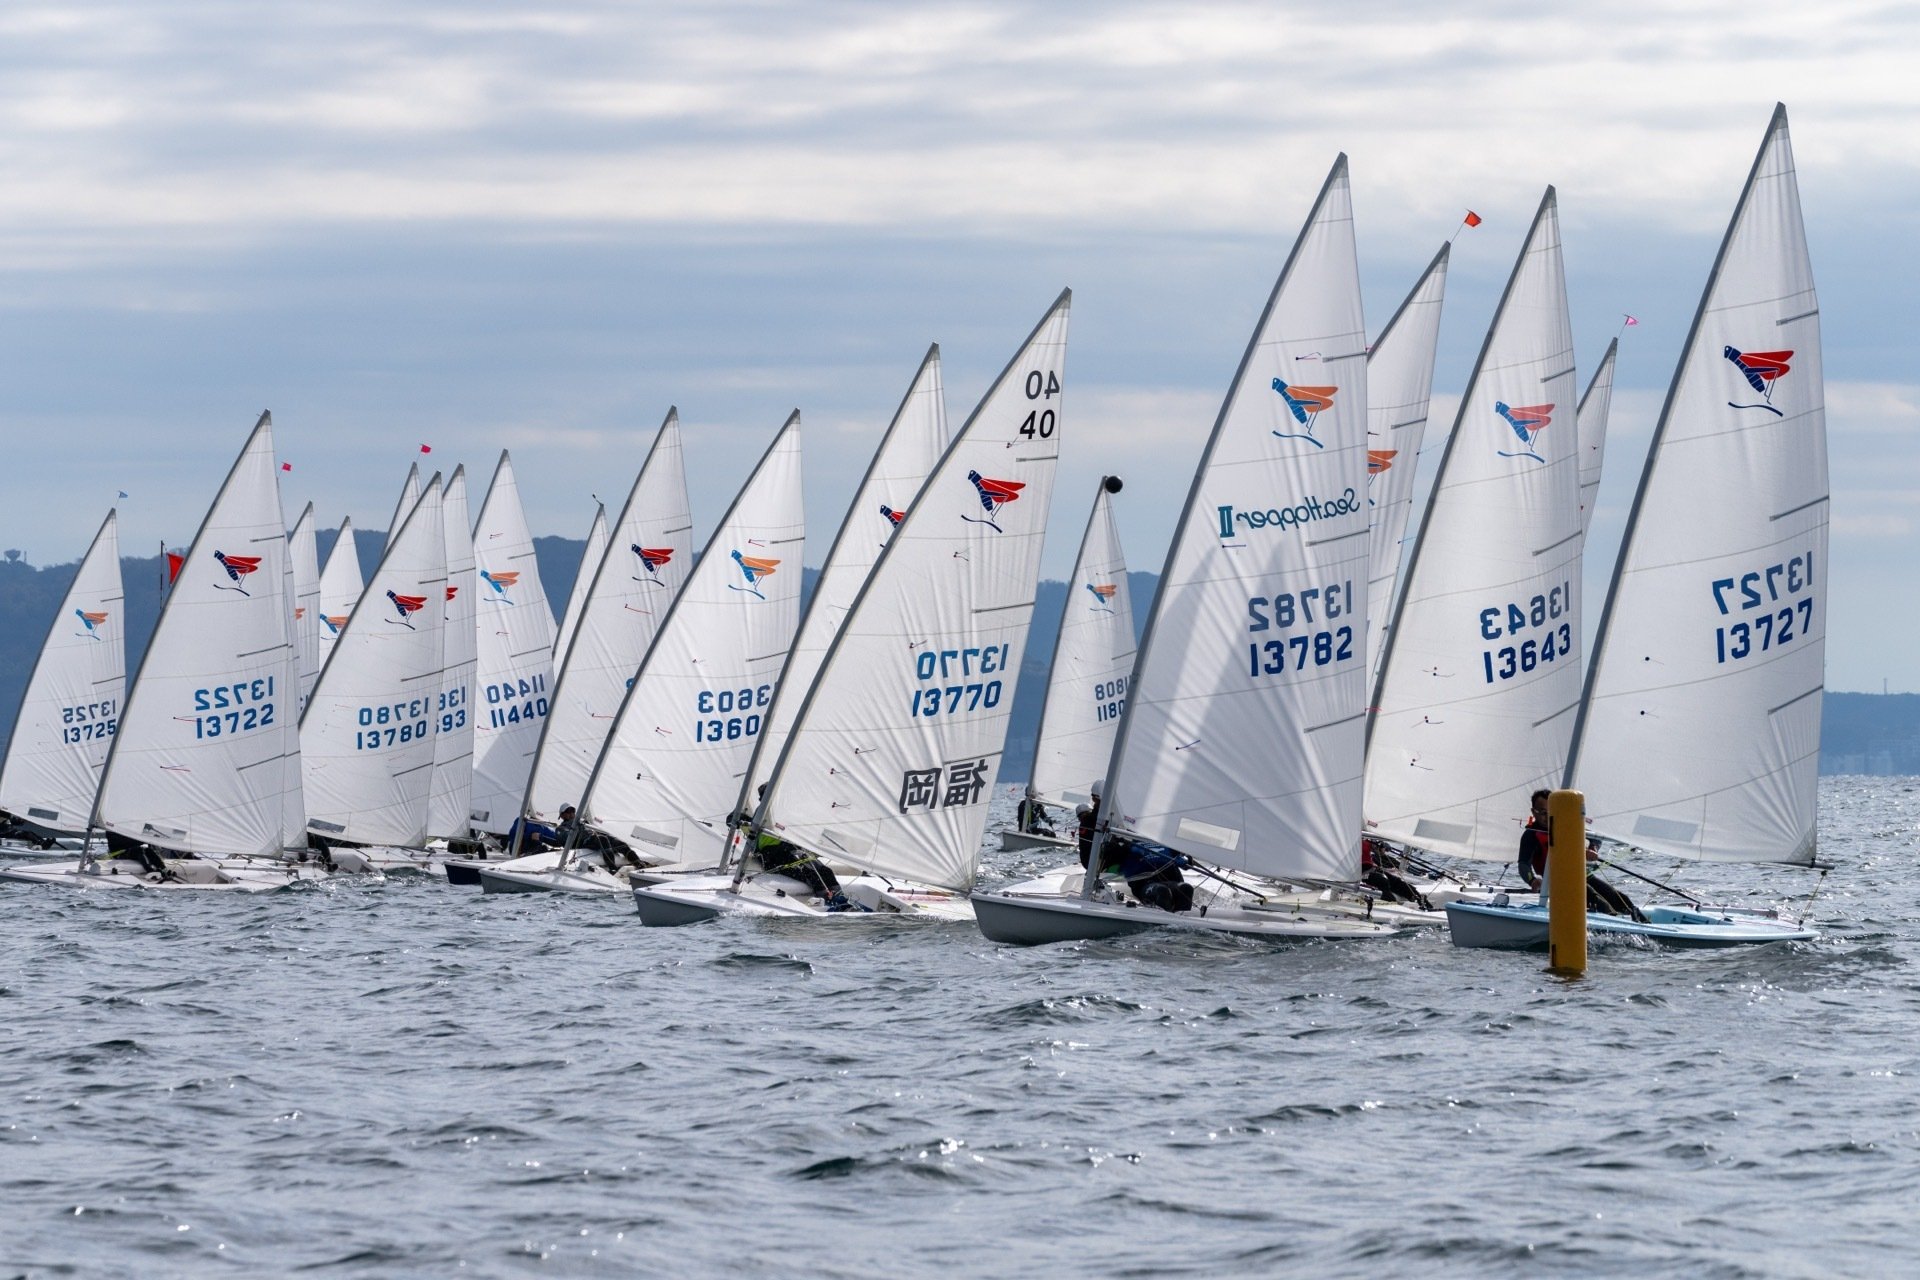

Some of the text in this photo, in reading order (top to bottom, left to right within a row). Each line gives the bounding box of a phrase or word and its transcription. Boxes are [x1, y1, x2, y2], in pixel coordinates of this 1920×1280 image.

[1020, 409, 1055, 440] 40
[1716, 597, 1812, 663] 13727
[1250, 626, 1353, 677] 13782
[1483, 622, 1570, 683] 13643
[491, 697, 548, 728] 11440
[912, 680, 1002, 717] 13770
[1097, 699, 1125, 722] 1180
[63, 718, 116, 744] 13725
[196, 703, 273, 739] 13722
[357, 720, 427, 750] 13780
[696, 714, 760, 743] 1360
